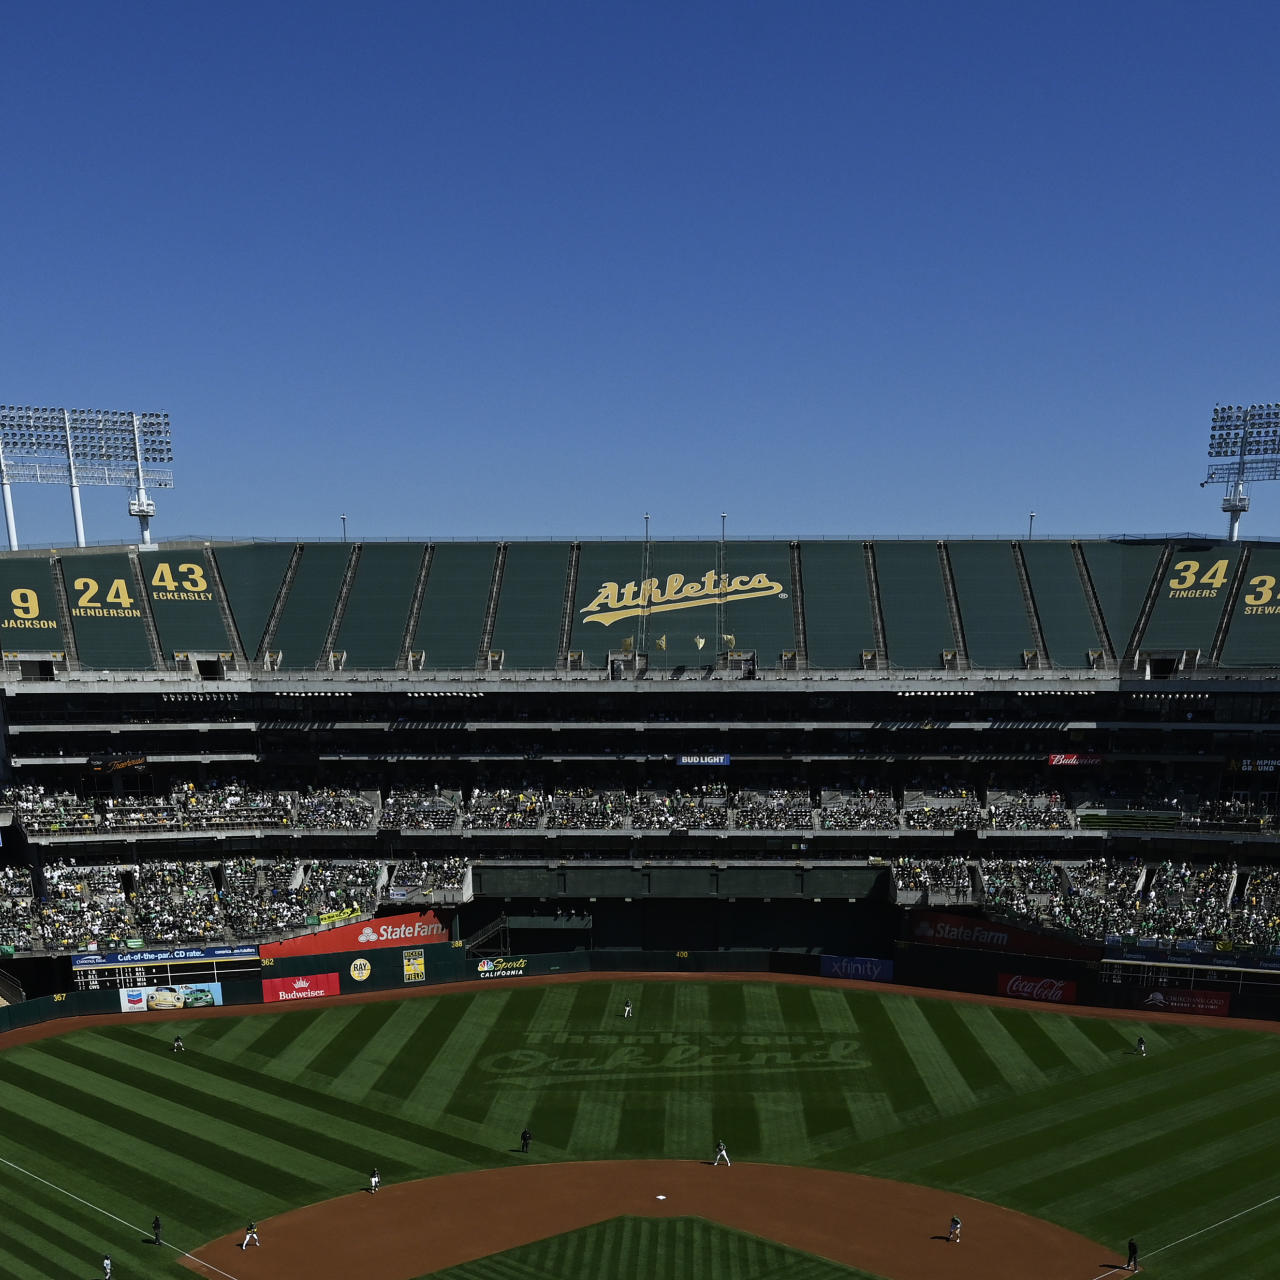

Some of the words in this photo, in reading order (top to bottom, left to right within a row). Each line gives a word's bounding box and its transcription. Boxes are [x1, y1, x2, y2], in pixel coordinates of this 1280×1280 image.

[151, 563, 208, 592] 43
[1169, 559, 1229, 589] 34
[74, 577, 134, 608] 24
[153, 591, 213, 600] ECKERSLEY
[580, 569, 782, 620] Athletics
[1169, 589, 1218, 598] FINGERS
[11, 588, 40, 618] 9
[72, 608, 141, 617] HENDERSON
[1, 619, 57, 629] JACKSON
[682, 756, 700, 764] BUD
[700, 756, 725, 764] LIGHT
[1052, 754, 1101, 766] Budweiser
[261, 958, 274, 967] 362
[353, 963, 368, 972] RAY
[493, 958, 527, 970] Sports
[481, 970, 523, 978] CALIFORNIA
[832, 960, 881, 980] xfinity
[405, 973, 424, 981] FIELD
[53, 993, 66, 1002] 367
[279, 990, 325, 1000] Budweiser
[525, 1031, 697, 1045] Thank
